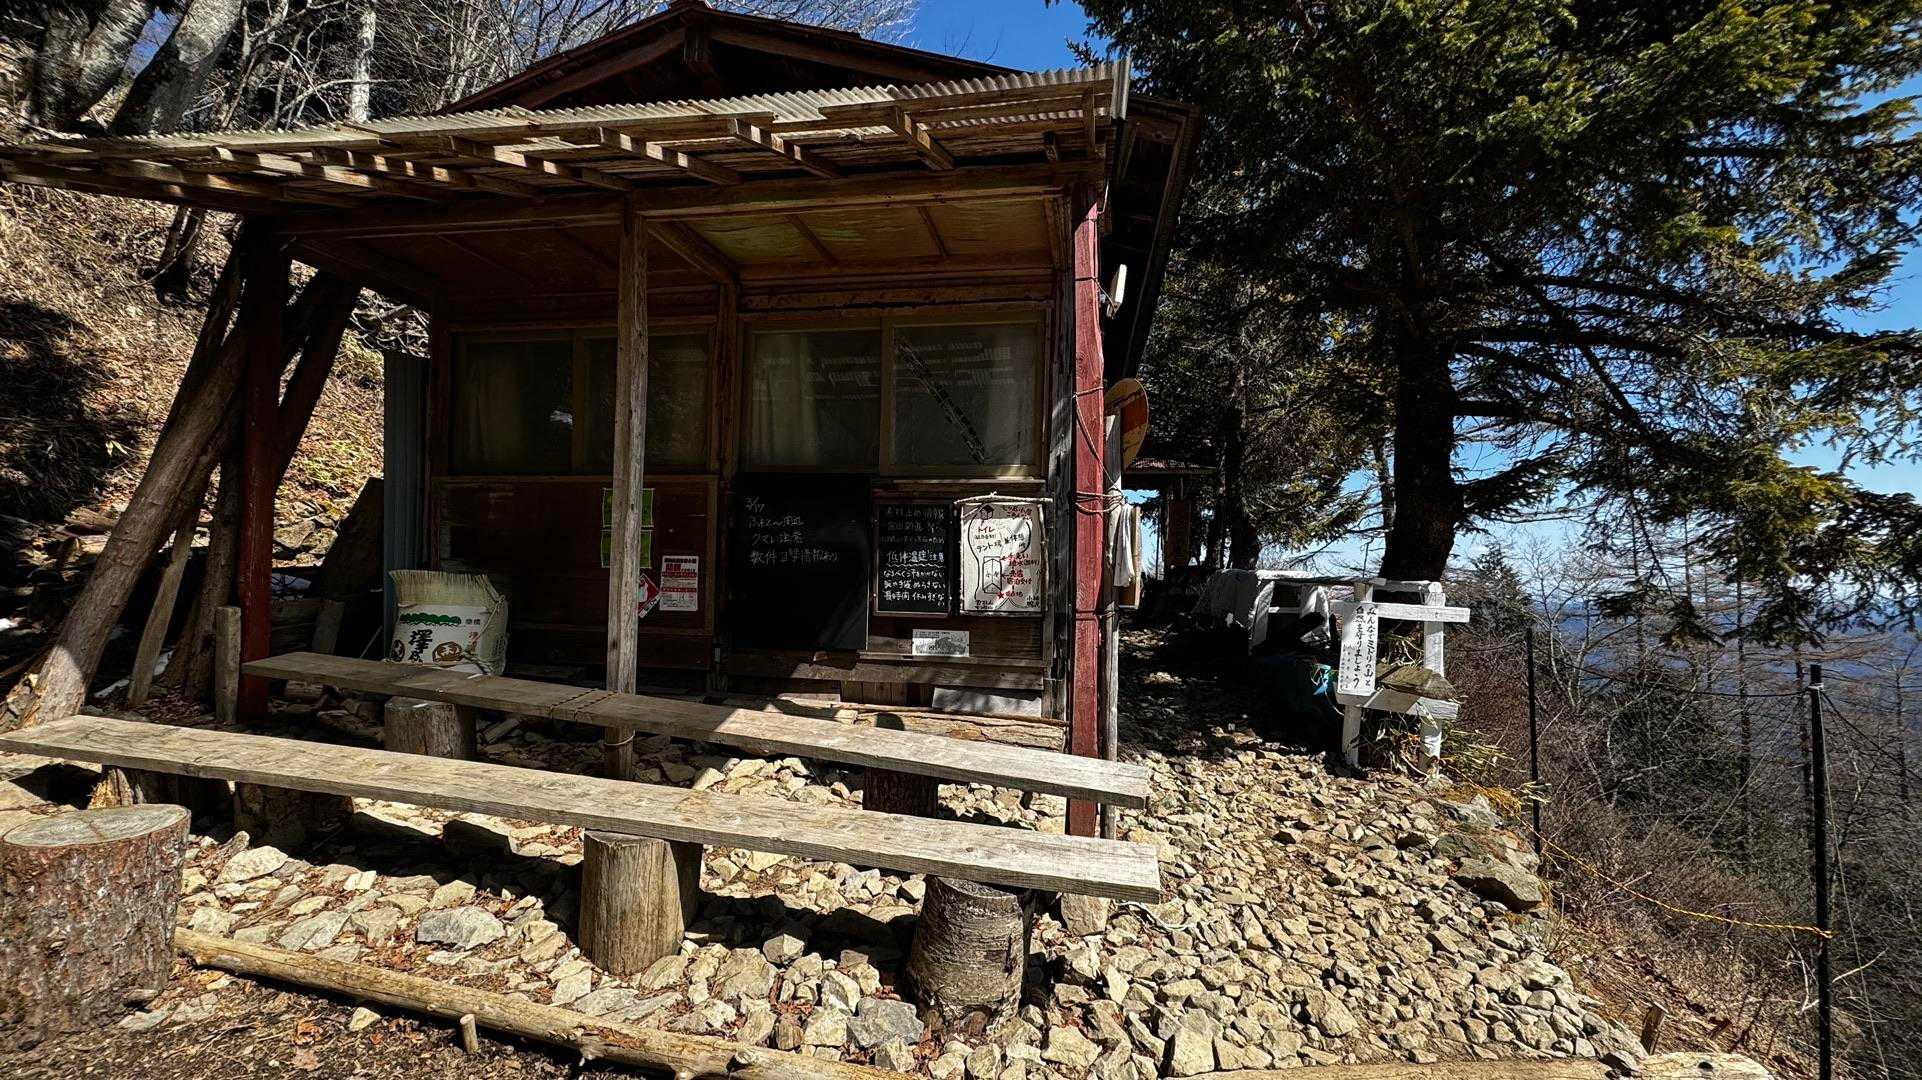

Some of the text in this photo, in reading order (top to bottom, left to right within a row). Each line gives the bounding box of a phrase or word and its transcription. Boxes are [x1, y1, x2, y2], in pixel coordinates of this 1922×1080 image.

[1353, 605, 1366, 688] 自然を守りましょう
